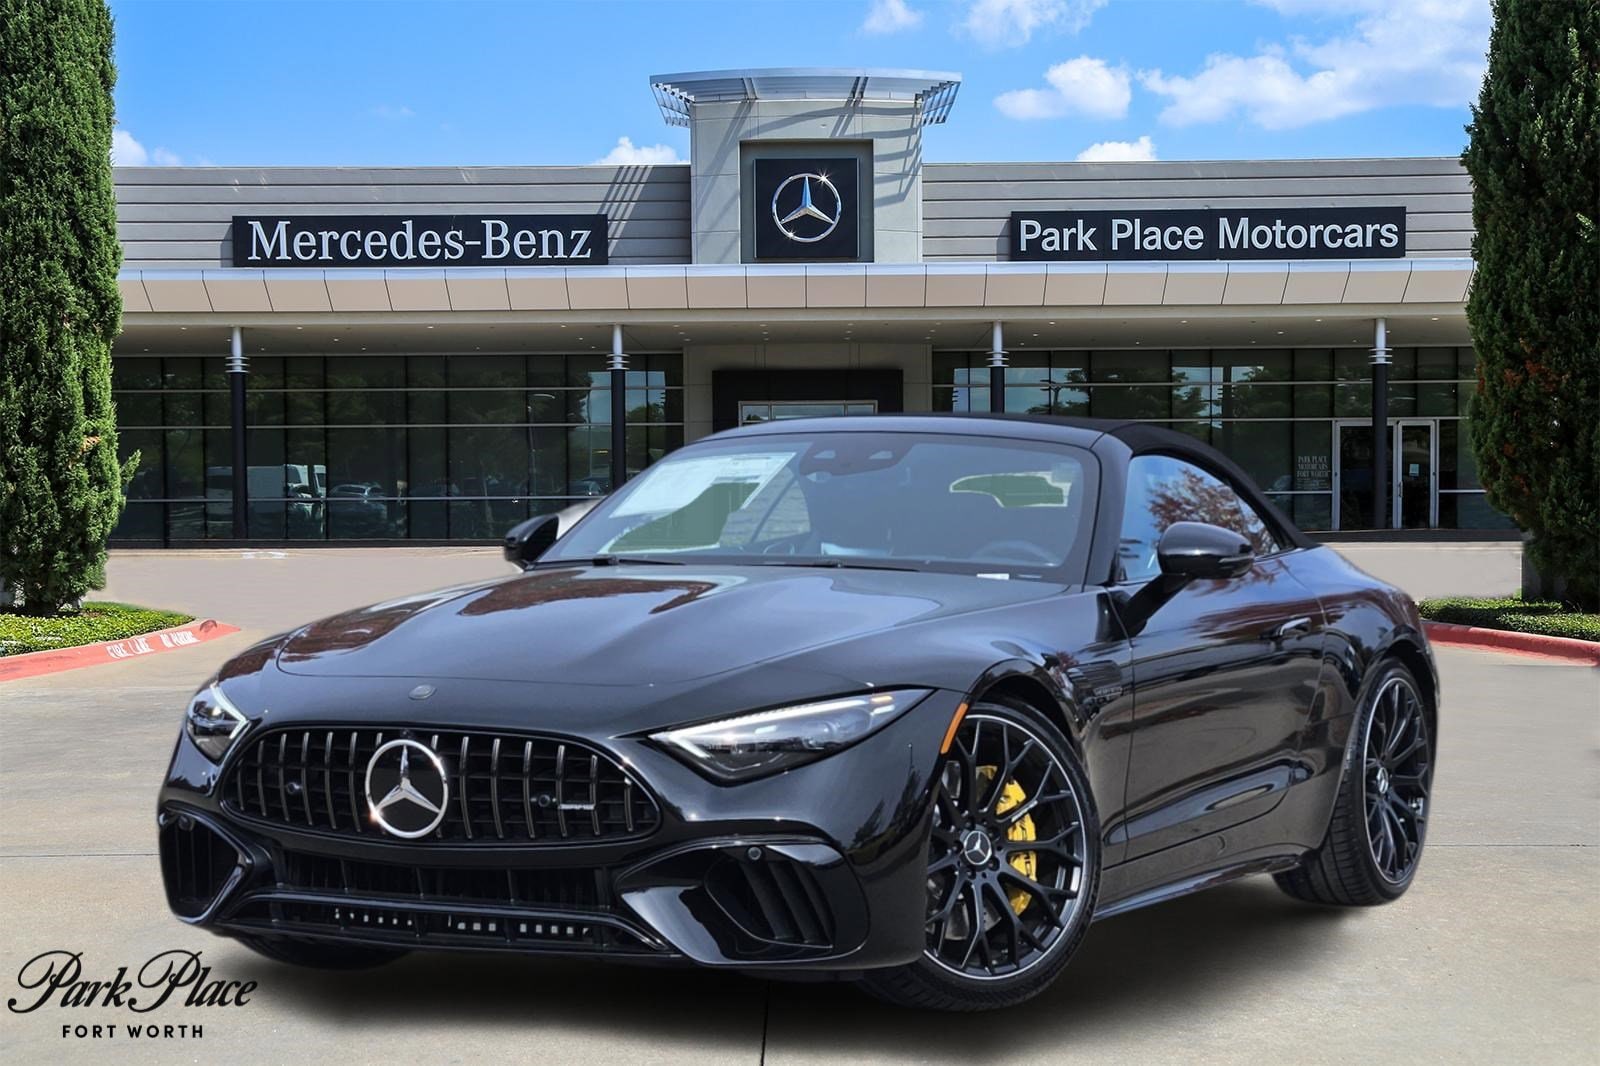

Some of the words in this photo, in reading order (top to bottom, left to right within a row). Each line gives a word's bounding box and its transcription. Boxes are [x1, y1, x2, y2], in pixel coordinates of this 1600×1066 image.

[247, 219, 592, 261] Mercedes-Benz
[1020, 219, 1098, 252] Park
[1111, 218, 1204, 251] Place
[1218, 217, 1399, 249] Motorcars
